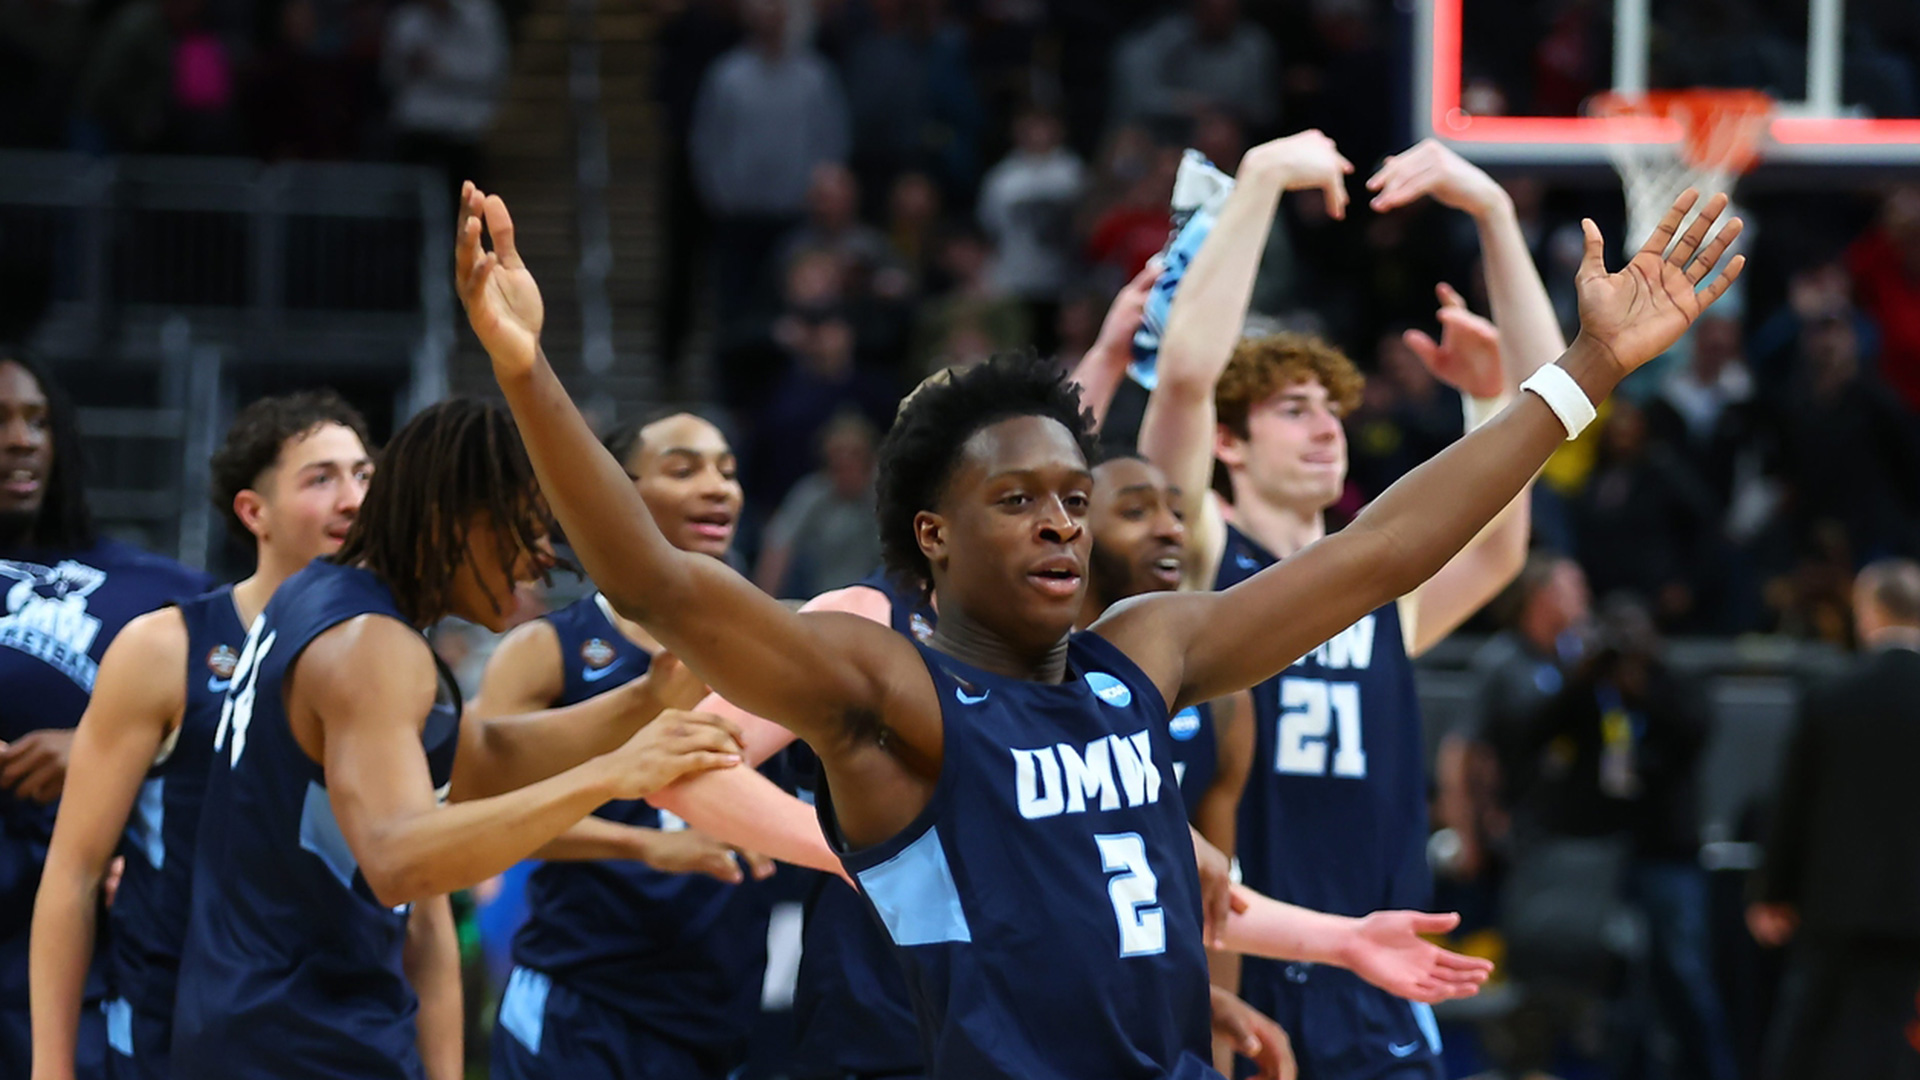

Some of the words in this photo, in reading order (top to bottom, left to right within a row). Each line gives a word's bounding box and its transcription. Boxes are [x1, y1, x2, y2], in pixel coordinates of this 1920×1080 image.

[1009, 729, 1162, 820] UMW
[1274, 676, 1367, 779] 21
[1093, 832, 1166, 958] 2
